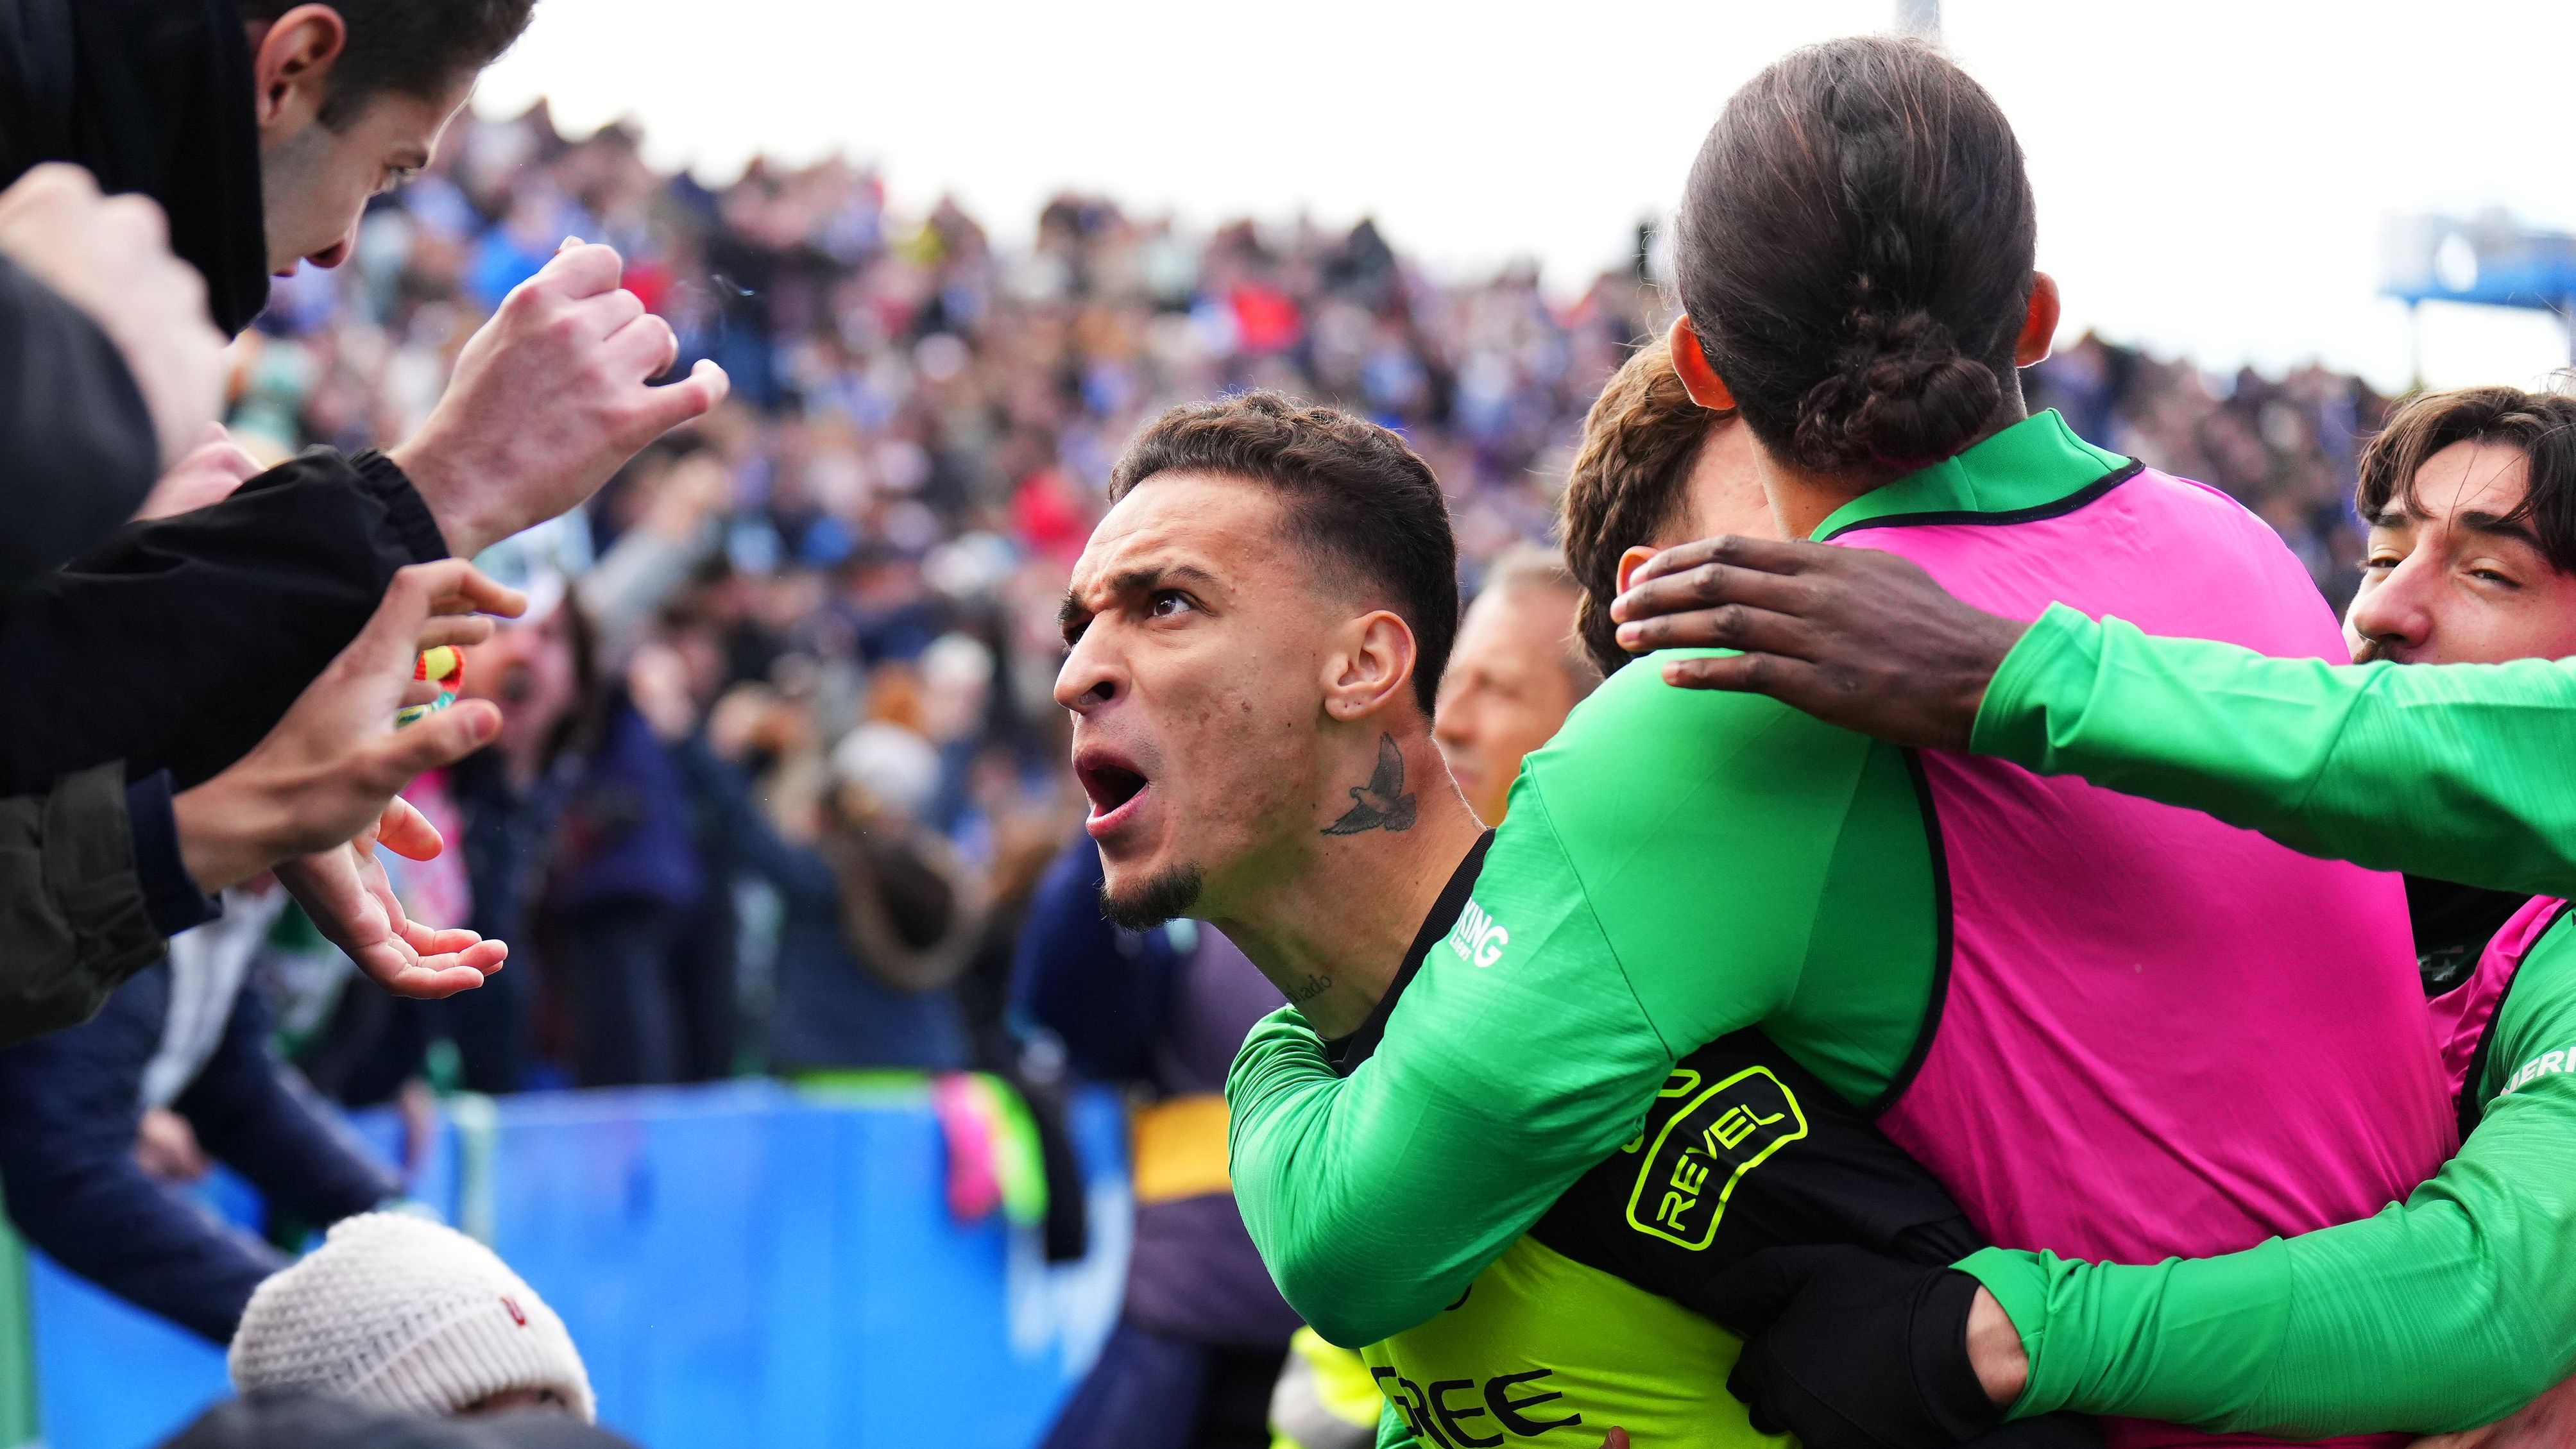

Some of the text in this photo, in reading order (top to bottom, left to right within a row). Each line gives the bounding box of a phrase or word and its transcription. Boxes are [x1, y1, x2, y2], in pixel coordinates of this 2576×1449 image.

[1453, 896, 1509, 968] KING
[1656, 1103, 1786, 1232] REVEL
[1370, 1366, 1583, 1449] GREE
